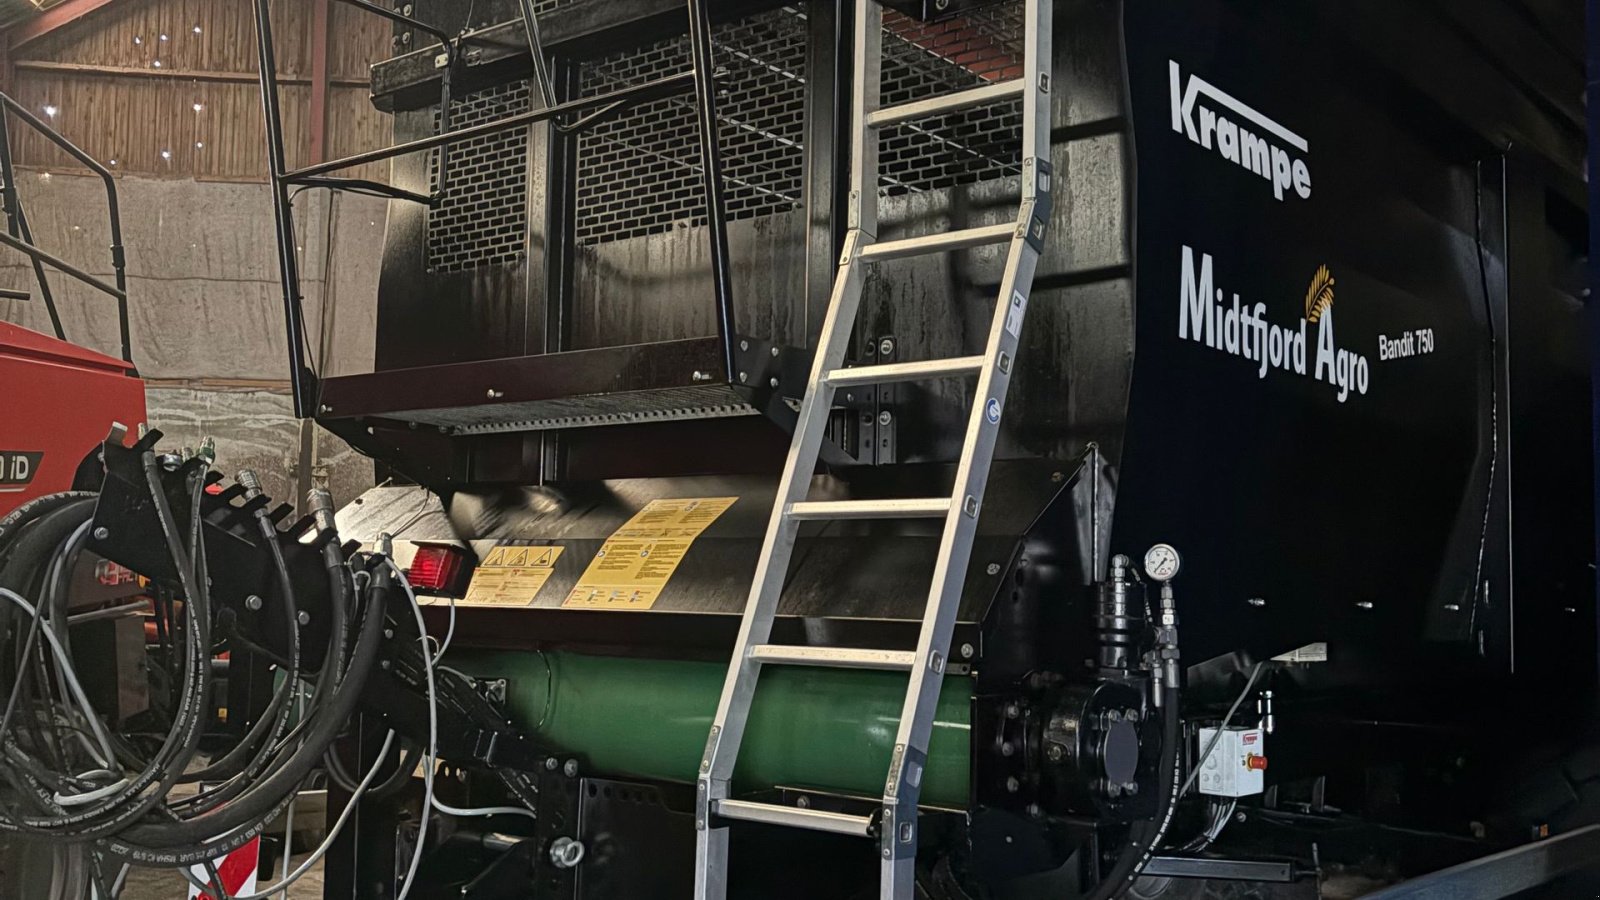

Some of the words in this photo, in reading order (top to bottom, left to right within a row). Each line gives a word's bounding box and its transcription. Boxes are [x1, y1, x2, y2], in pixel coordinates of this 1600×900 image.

[1169, 60, 1311, 201] Krampe
[1178, 245, 1306, 379] Midtfjord
[1315, 304, 1369, 403] Agro
[1379, 331, 1415, 361] Bandit
[1416, 328, 1434, 354] 750
[10, 455, 29, 480] iD
